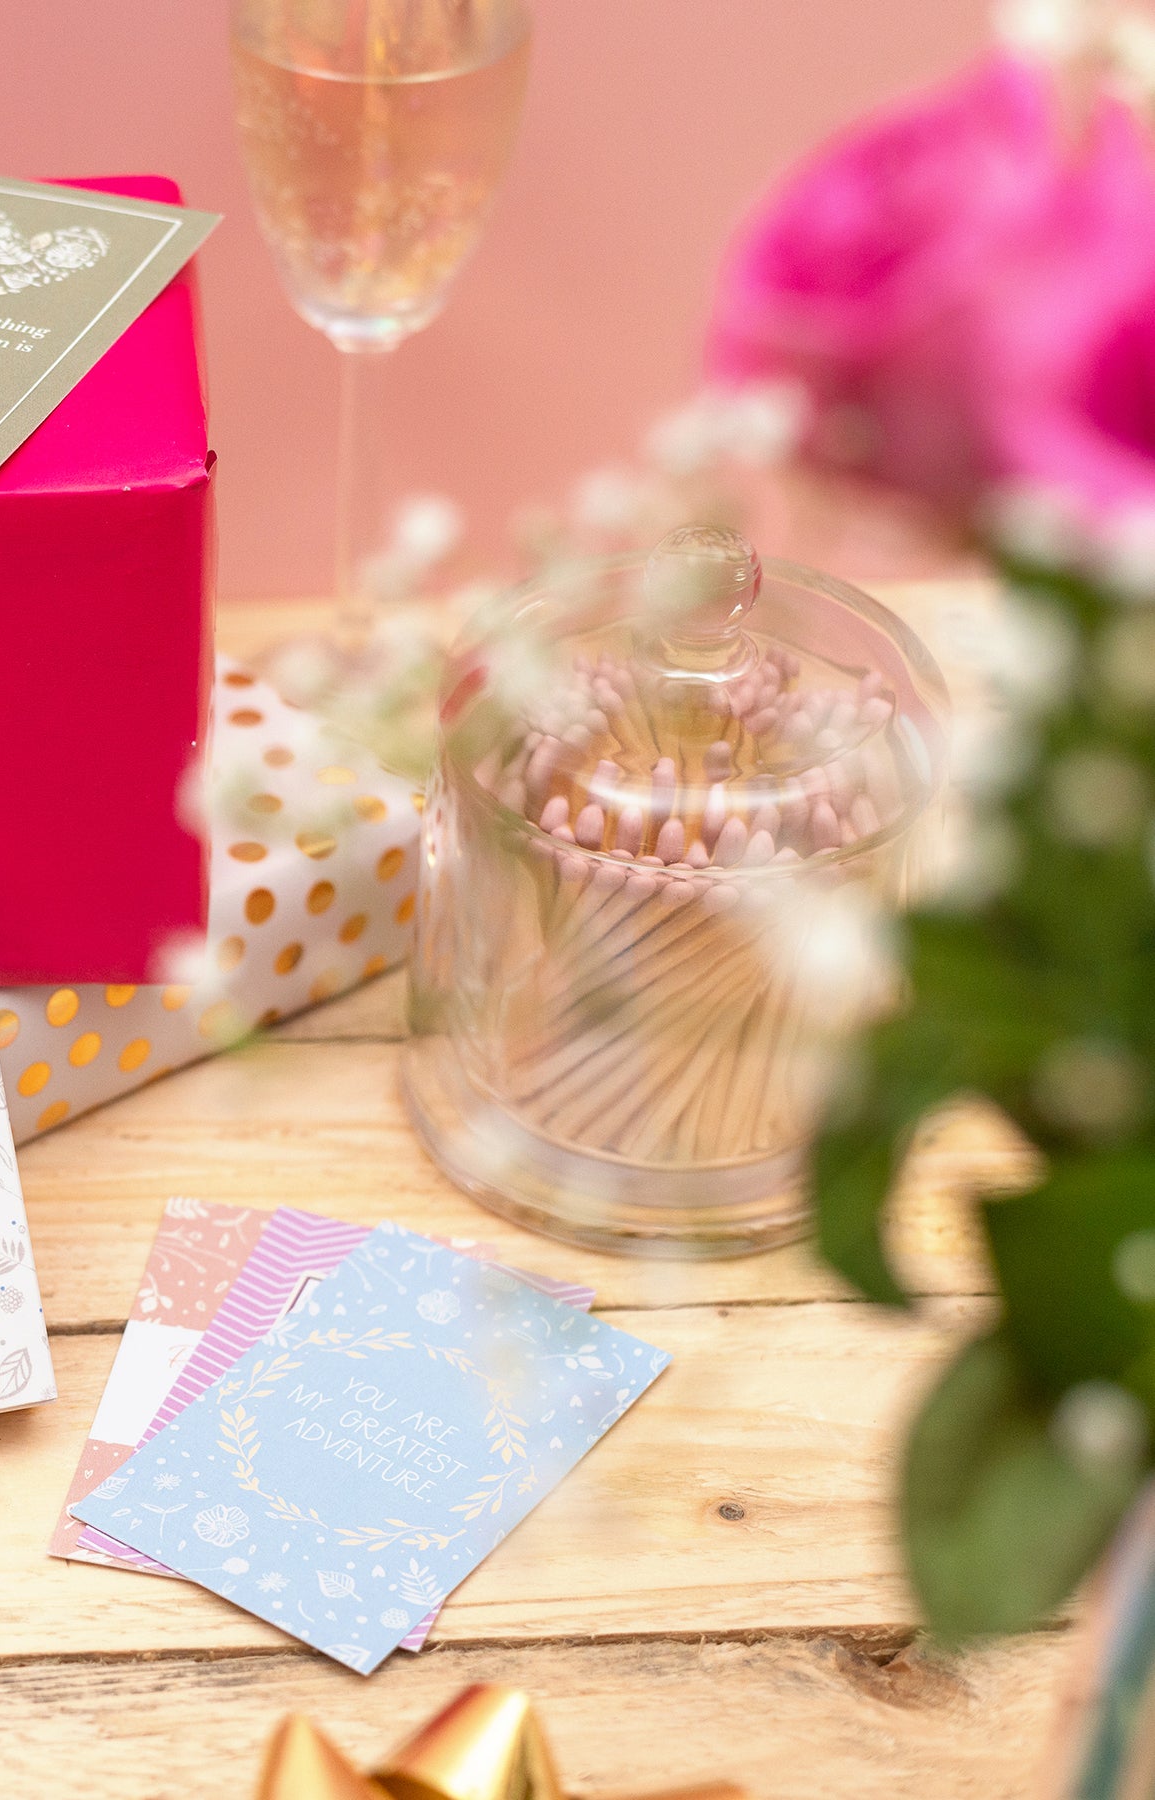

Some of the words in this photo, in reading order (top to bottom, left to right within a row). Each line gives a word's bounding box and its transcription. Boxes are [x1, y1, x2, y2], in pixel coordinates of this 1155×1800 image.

[15, 338, 33, 353] is
[287, 1383, 333, 1412] MY
[339, 1409, 469, 1481] GREATEST
[342, 1376, 398, 1412] YOU
[401, 1411, 460, 1446] ARE
[284, 1417, 438, 1503] ADVENTURE.
